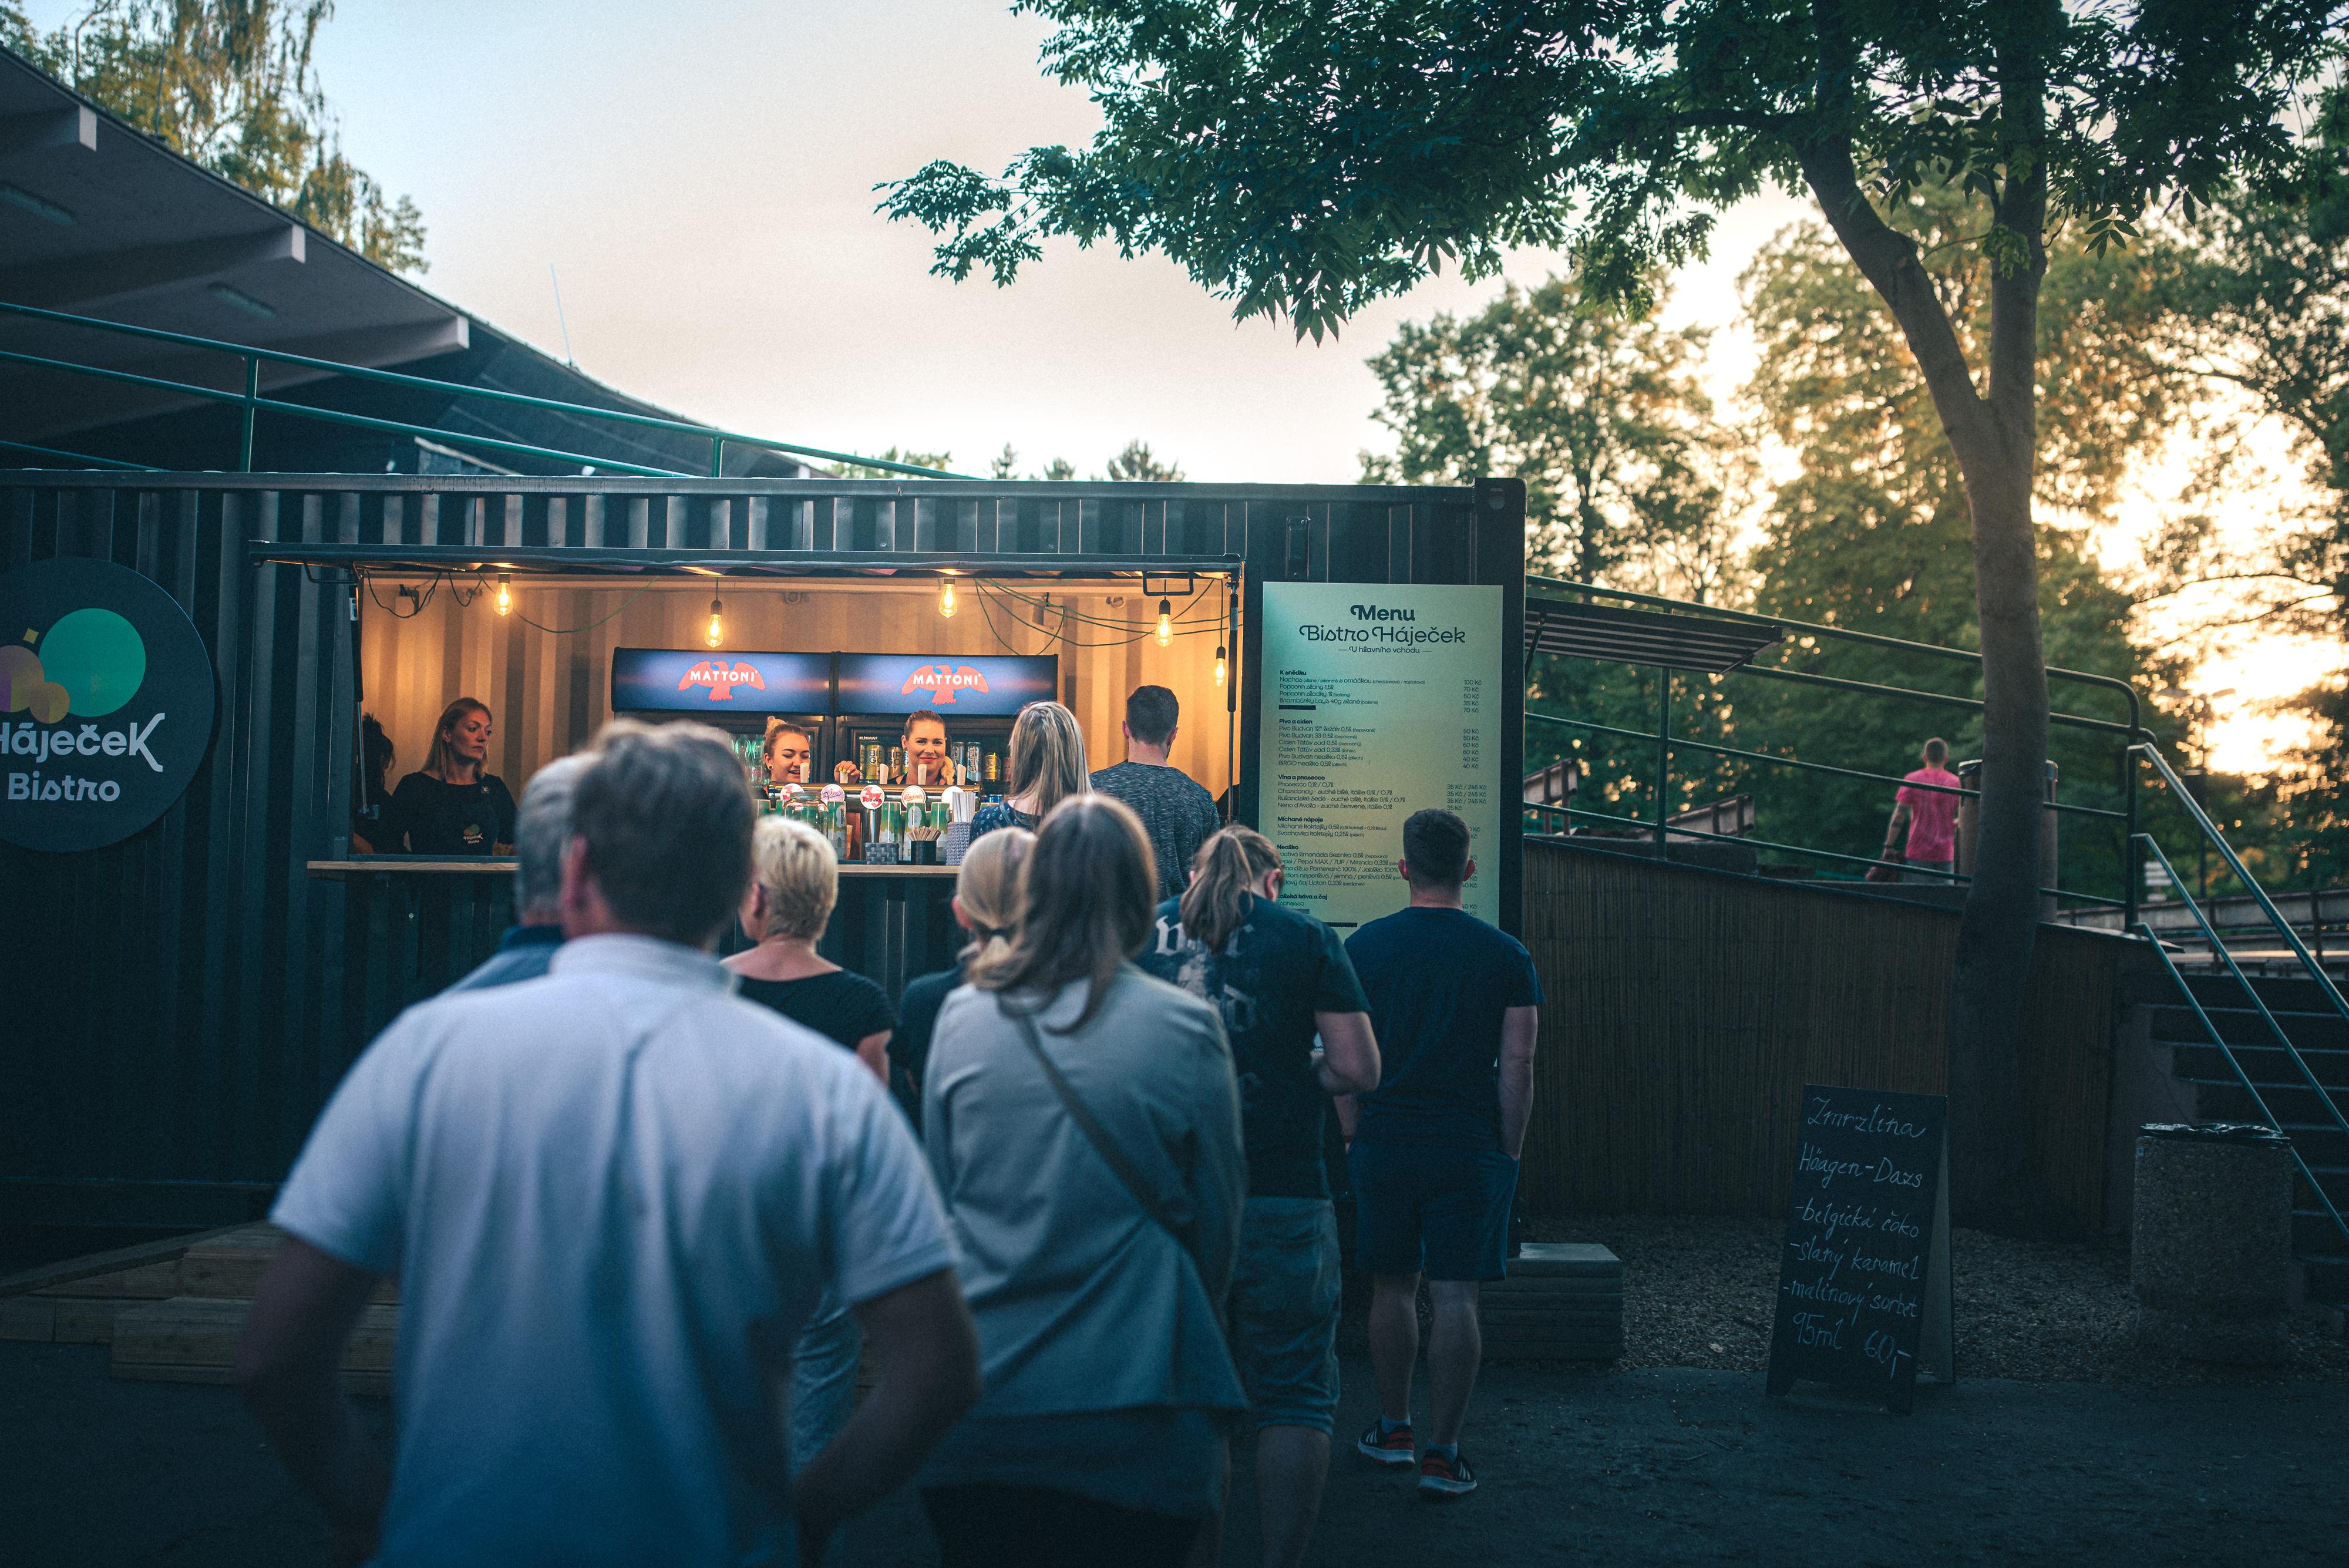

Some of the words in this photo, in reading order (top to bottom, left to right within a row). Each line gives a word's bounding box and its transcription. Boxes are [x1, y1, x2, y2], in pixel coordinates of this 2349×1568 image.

[1350, 604, 1415, 621] Menu
[1299, 625, 1369, 642] Bistro
[1371, 626, 1466, 647] Háječek
[690, 669, 756, 682] MATTONI
[913, 673, 979, 686] MATTONI
[8, 770, 120, 802] Bistro
[1808, 1096, 1926, 1139] Zmrzlina
[1882, 1210, 1919, 1239] čoko
[1851, 1246, 1919, 1280] karamel
[1870, 1292, 1918, 1318] sorbet
